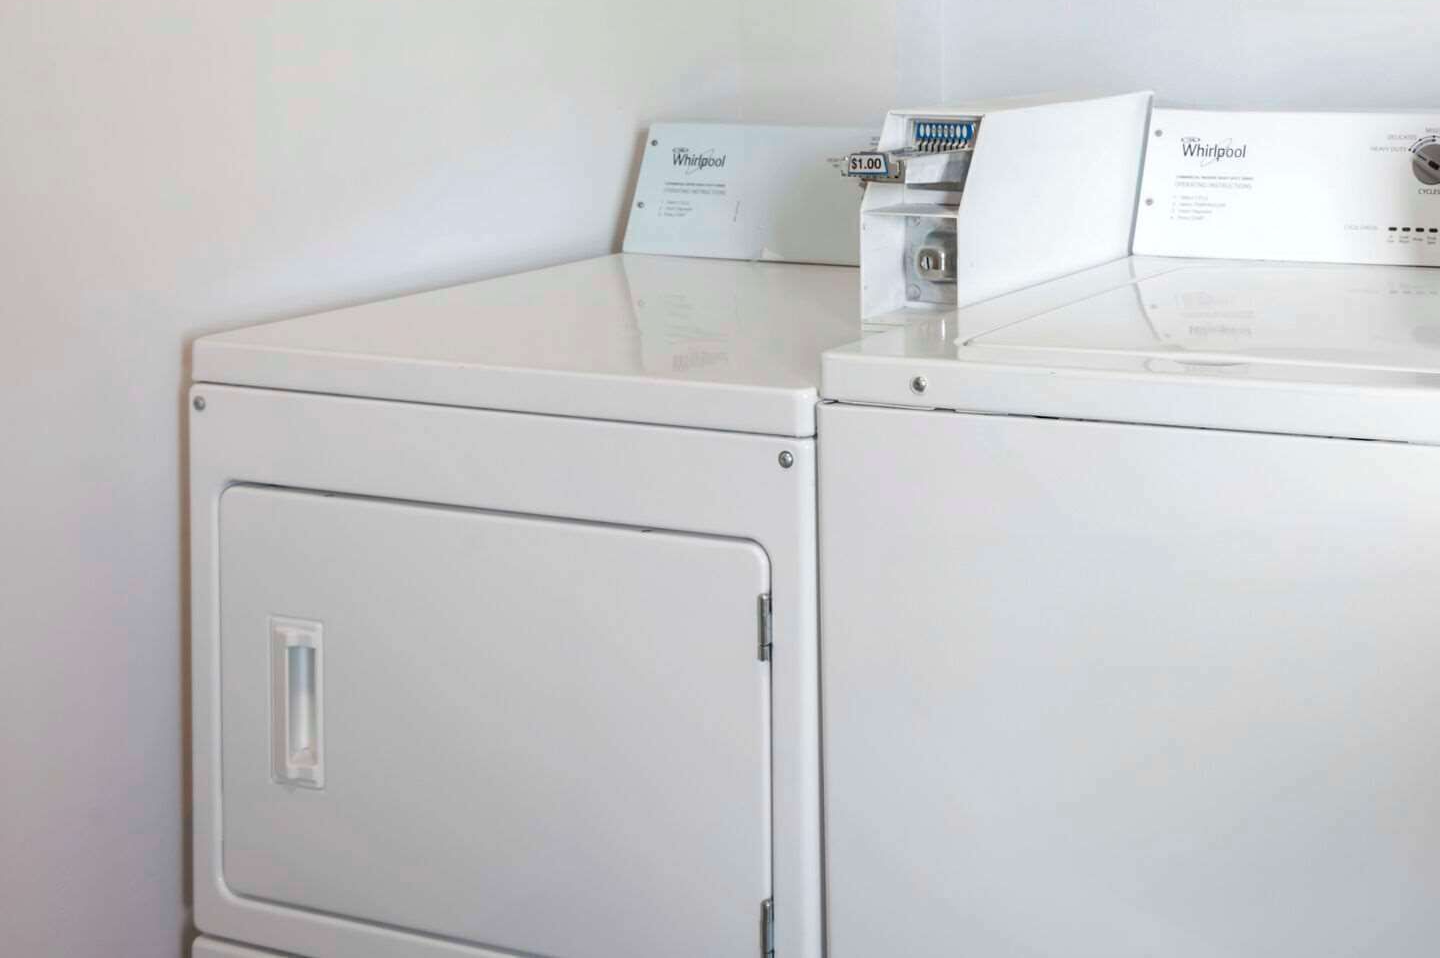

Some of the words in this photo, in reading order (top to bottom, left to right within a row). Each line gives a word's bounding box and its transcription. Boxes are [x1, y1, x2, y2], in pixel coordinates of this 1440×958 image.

[1182, 144, 1247, 161] Whirlpool
[672, 153, 726, 170] Whirlpool
[851, 158, 882, 170] $1.00
